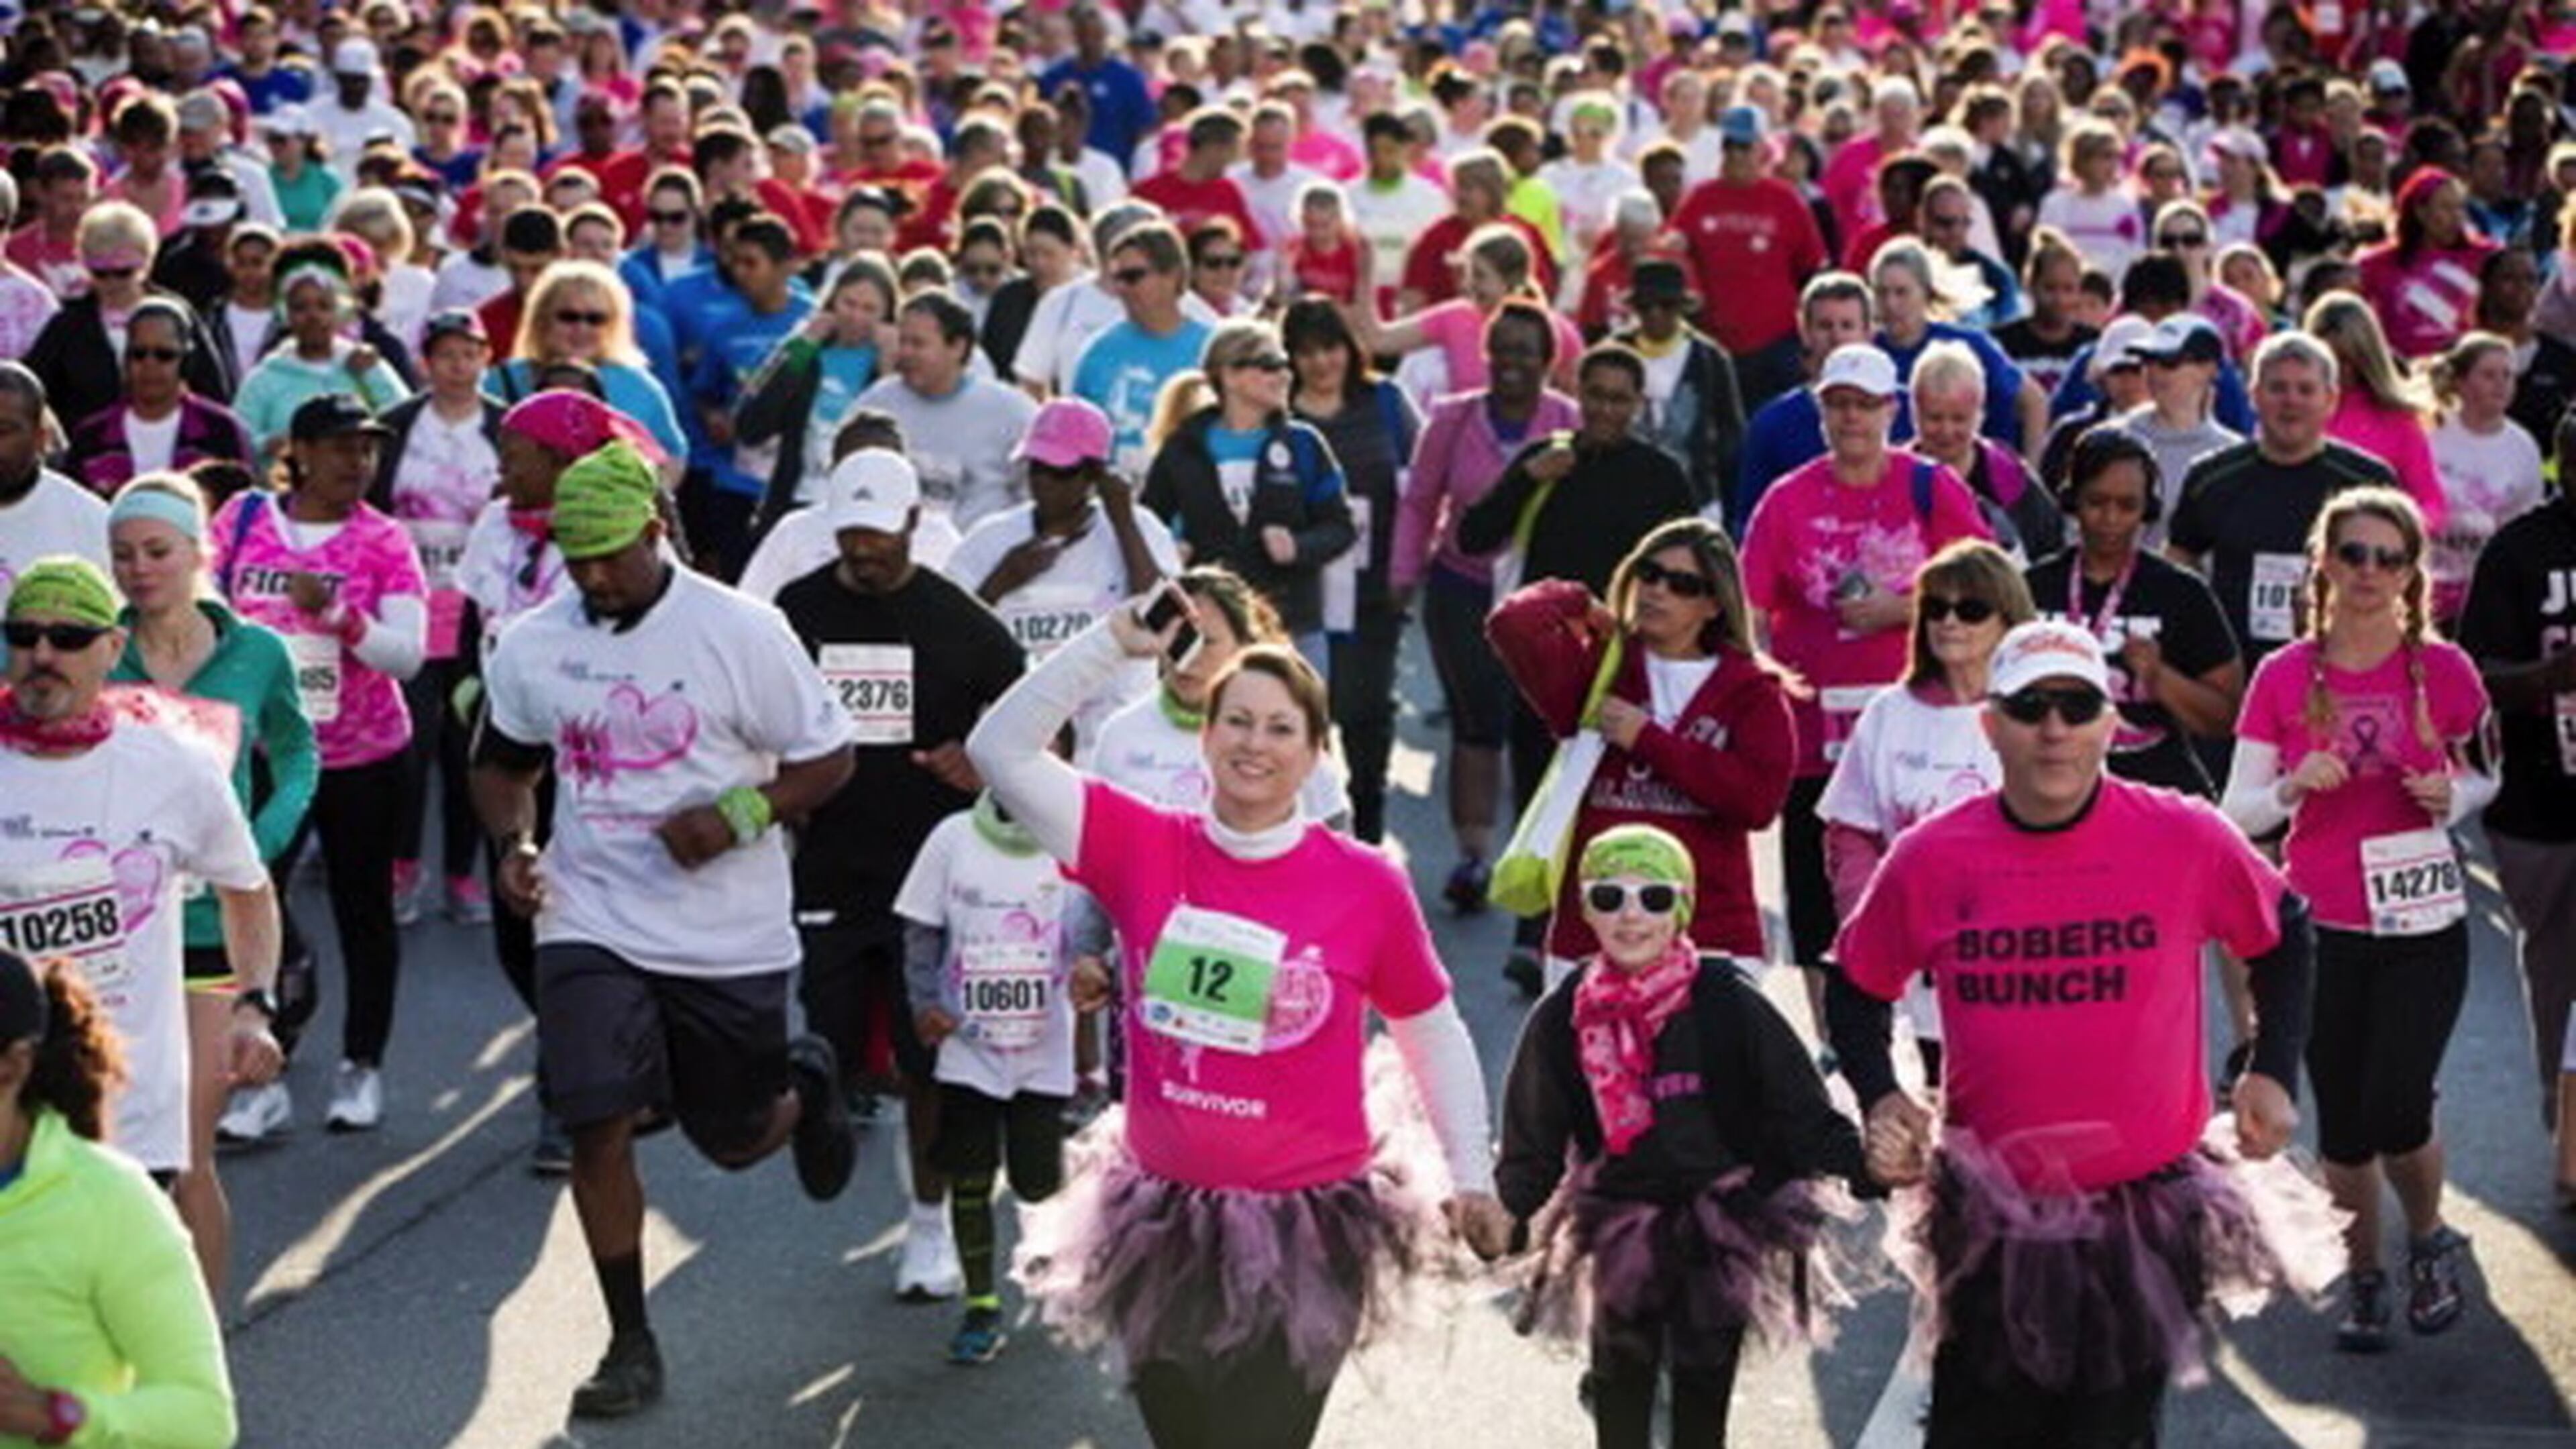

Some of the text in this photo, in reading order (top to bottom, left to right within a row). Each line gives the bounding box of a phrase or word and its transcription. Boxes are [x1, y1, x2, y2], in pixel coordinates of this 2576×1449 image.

[239, 567, 347, 598] FIGT
[827, 679, 909, 711] 2376
[2372, 861, 2458, 904] 14278
[0, 897, 119, 952] 10258
[1957, 914, 2157, 962] BOBERG
[964, 979, 1044, 1011] 10601
[1189, 955, 1234, 1004] 12
[1956, 965, 2127, 1008] BUNCH
[1161, 1080, 1267, 1120] SURVIVOR
